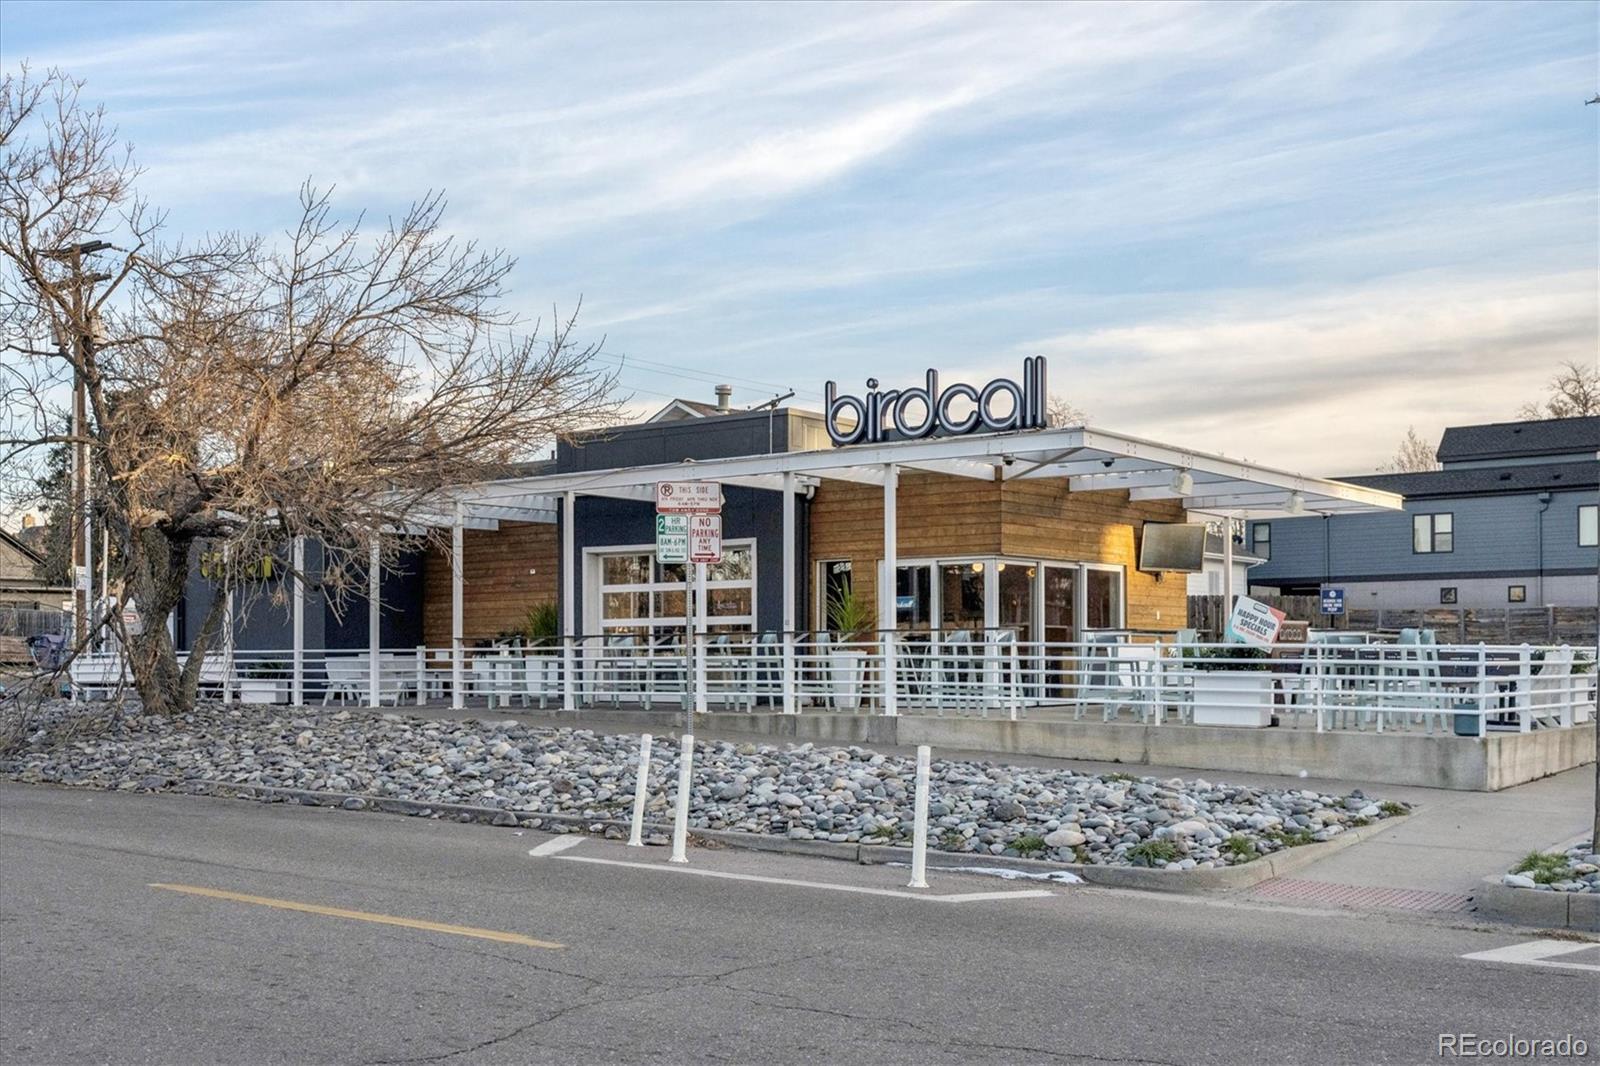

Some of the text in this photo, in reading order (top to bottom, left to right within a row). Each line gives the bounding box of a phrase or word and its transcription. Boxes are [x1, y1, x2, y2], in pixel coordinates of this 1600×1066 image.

[825, 355, 1047, 445] birdcall
[679, 486, 709, 494] THIS SIDE
[658, 518, 665, 532] 2
[671, 517, 681, 525] HR
[699, 517, 711, 527] NO
[692, 528, 719, 538] PARKING
[1237, 608, 1259, 622] HAPPY
[1258, 617, 1276, 631] HOUR
[1240, 618, 1268, 637] SPECIALS
